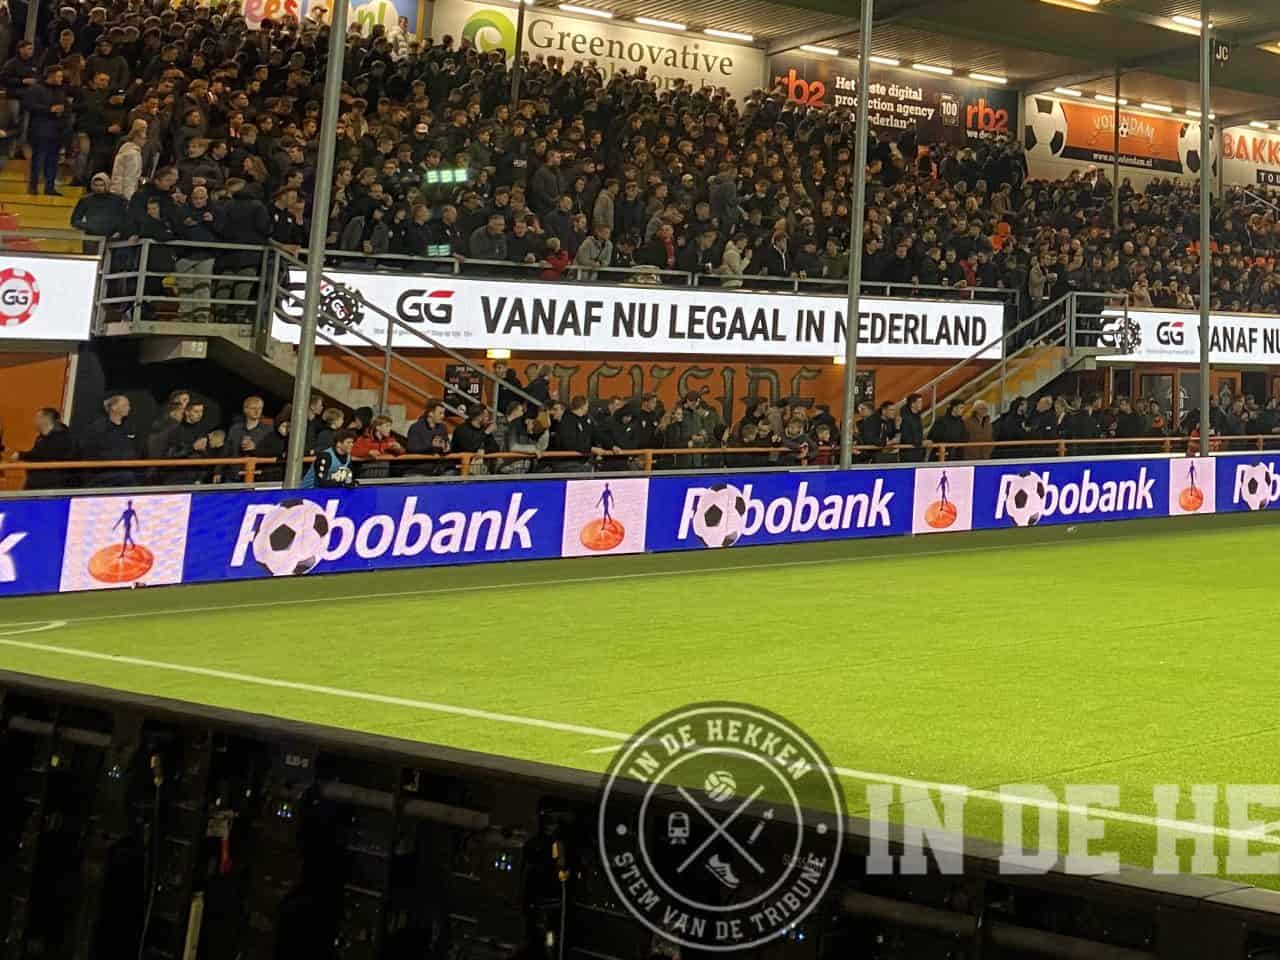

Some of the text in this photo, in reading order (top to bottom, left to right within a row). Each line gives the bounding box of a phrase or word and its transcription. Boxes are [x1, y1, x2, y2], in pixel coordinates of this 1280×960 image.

[528, 18, 734, 76] Greenovative
[834, 94, 936, 121] proction agency
[835, 76, 856, 90] Het
[888, 83, 923, 101] digital
[966, 97, 1009, 134] rb2
[481, 295, 987, 348] VANAF NU LEGAAL IN NEDERLAND
[1197, 325, 1258, 355] ANAF
[678, 478, 895, 539] Rbobank
[995, 467, 1156, 519] Rbobank
[231, 492, 539, 568] Rbobank
